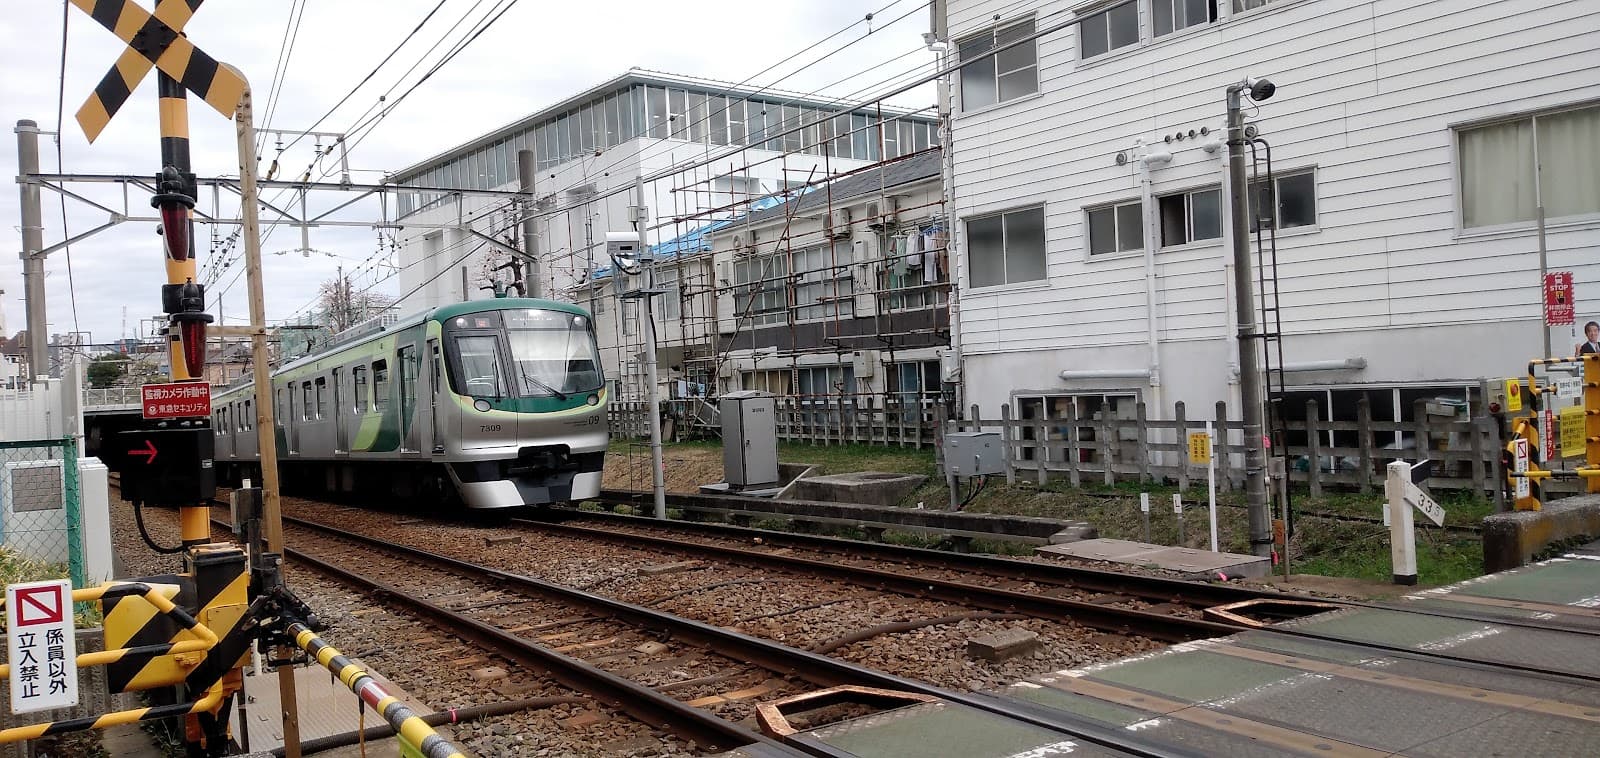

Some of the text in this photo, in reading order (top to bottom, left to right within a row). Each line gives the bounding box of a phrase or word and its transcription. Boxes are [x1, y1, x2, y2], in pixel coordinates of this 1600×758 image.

[145, 386, 208, 400] 監視カメラ作動中
[159, 403, 208, 413] 東急セキュリティ
[588, 415, 600, 425] 09
[18, 631, 41, 699] 立入禁止
[46, 628, 68, 695] 係員以外
